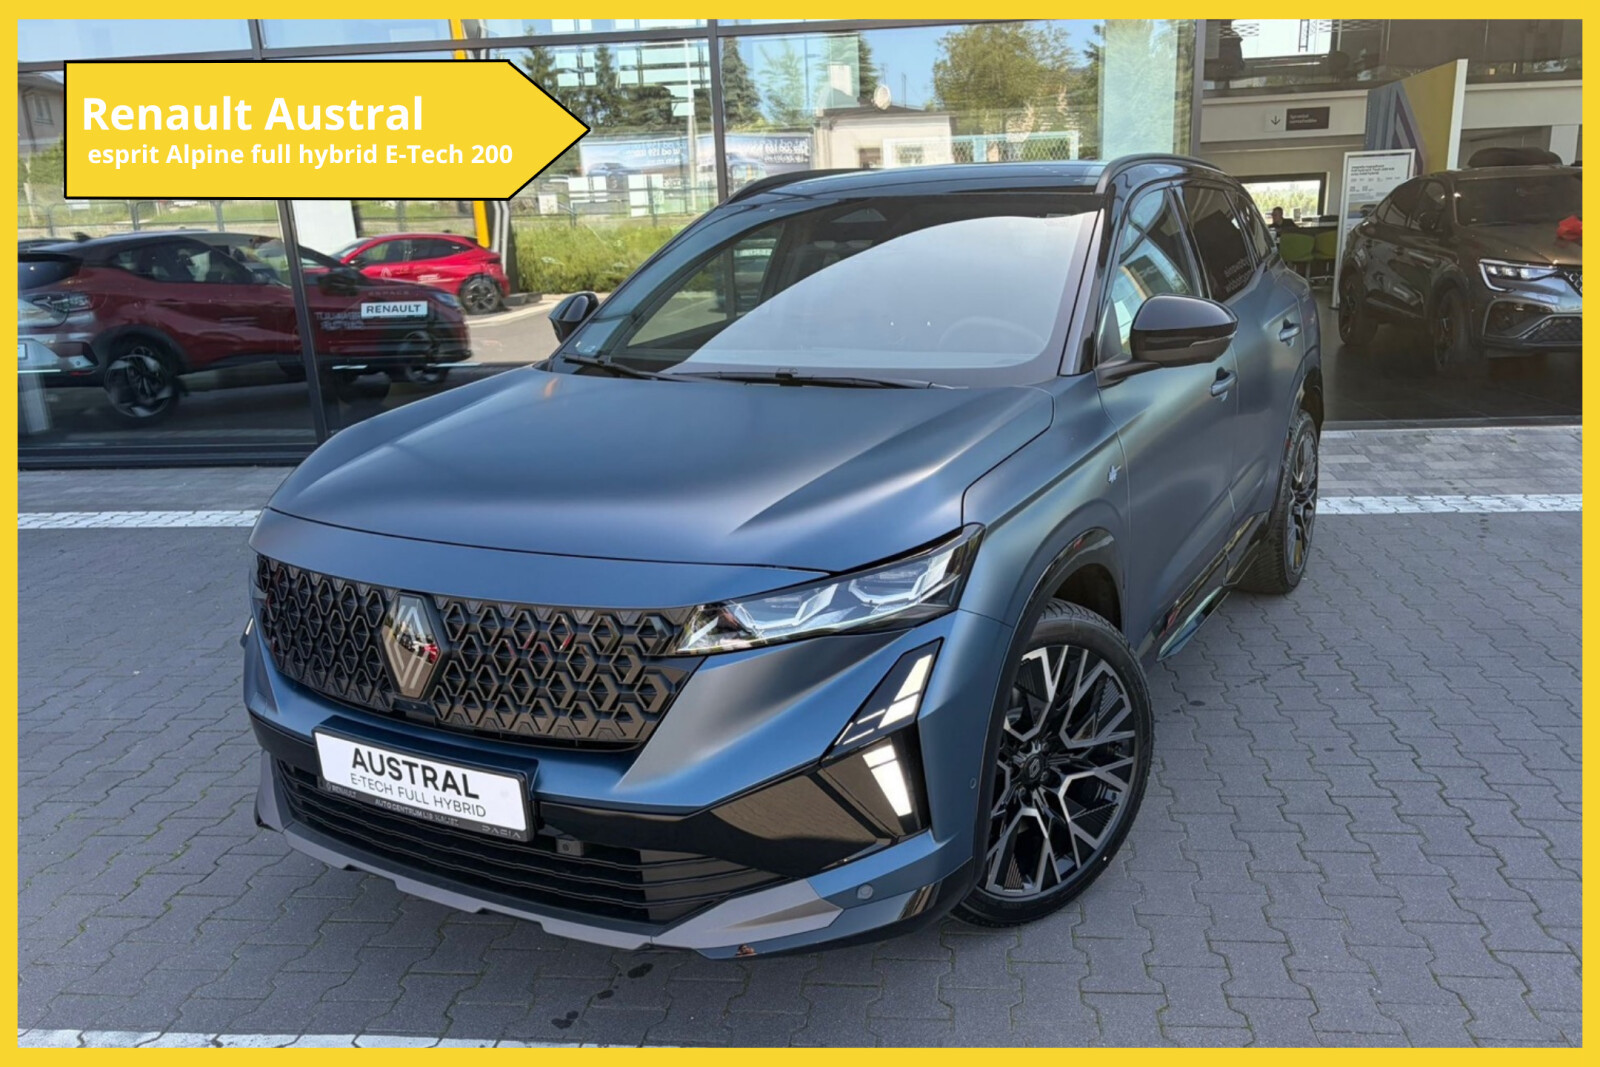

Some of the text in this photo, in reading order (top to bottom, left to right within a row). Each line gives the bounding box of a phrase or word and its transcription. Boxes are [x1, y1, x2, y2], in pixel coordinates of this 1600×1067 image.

[366, 304, 421, 314] RENAULT
[352, 747, 479, 799] AUSTRAL
[350, 773, 486, 817] E-TECH FULL HYBRID
[481, 824, 521, 839] DACIA
